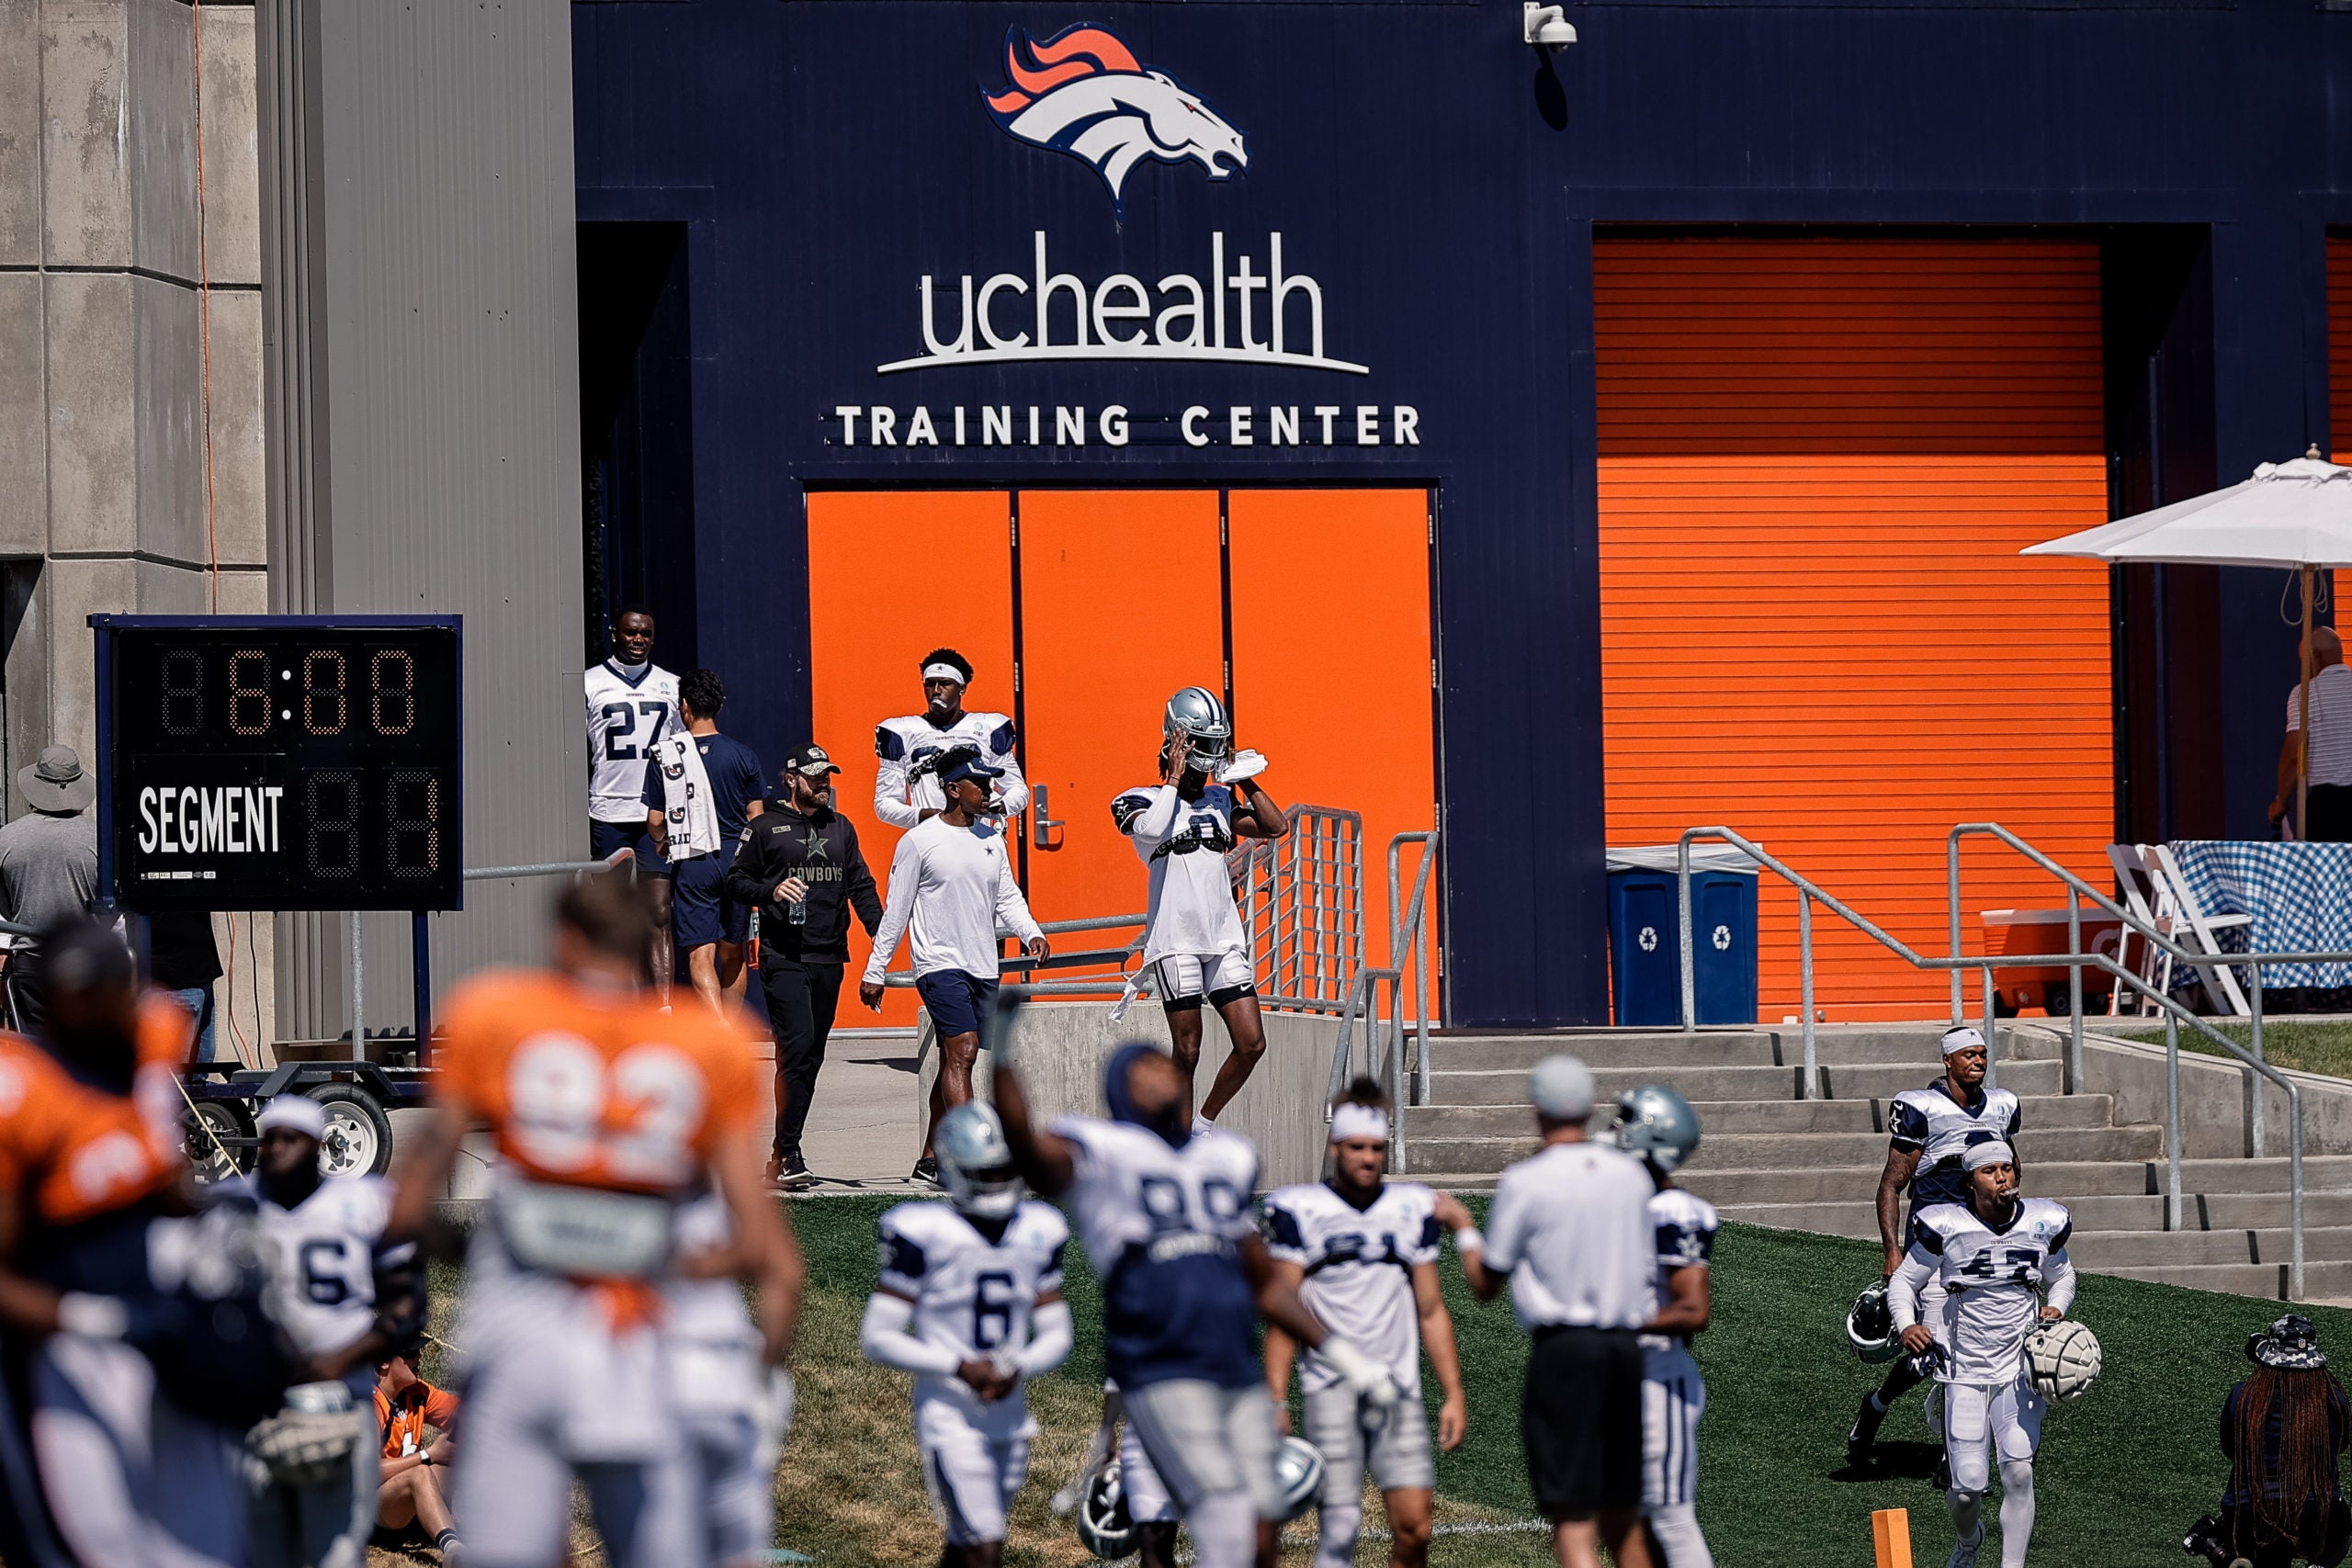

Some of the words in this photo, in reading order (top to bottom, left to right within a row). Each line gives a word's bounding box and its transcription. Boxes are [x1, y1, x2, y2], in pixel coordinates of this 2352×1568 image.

[921, 230, 1324, 362] uchealth
[834, 404, 1131, 446] TRAINING
[1180, 404, 1421, 446] CENTER
[228, 649, 415, 736] 6:00
[601, 701, 669, 761] 27
[139, 785, 283, 854] SEGMENT
[1959, 1249, 2041, 1280] 47
[974, 1272, 1016, 1349] 6
